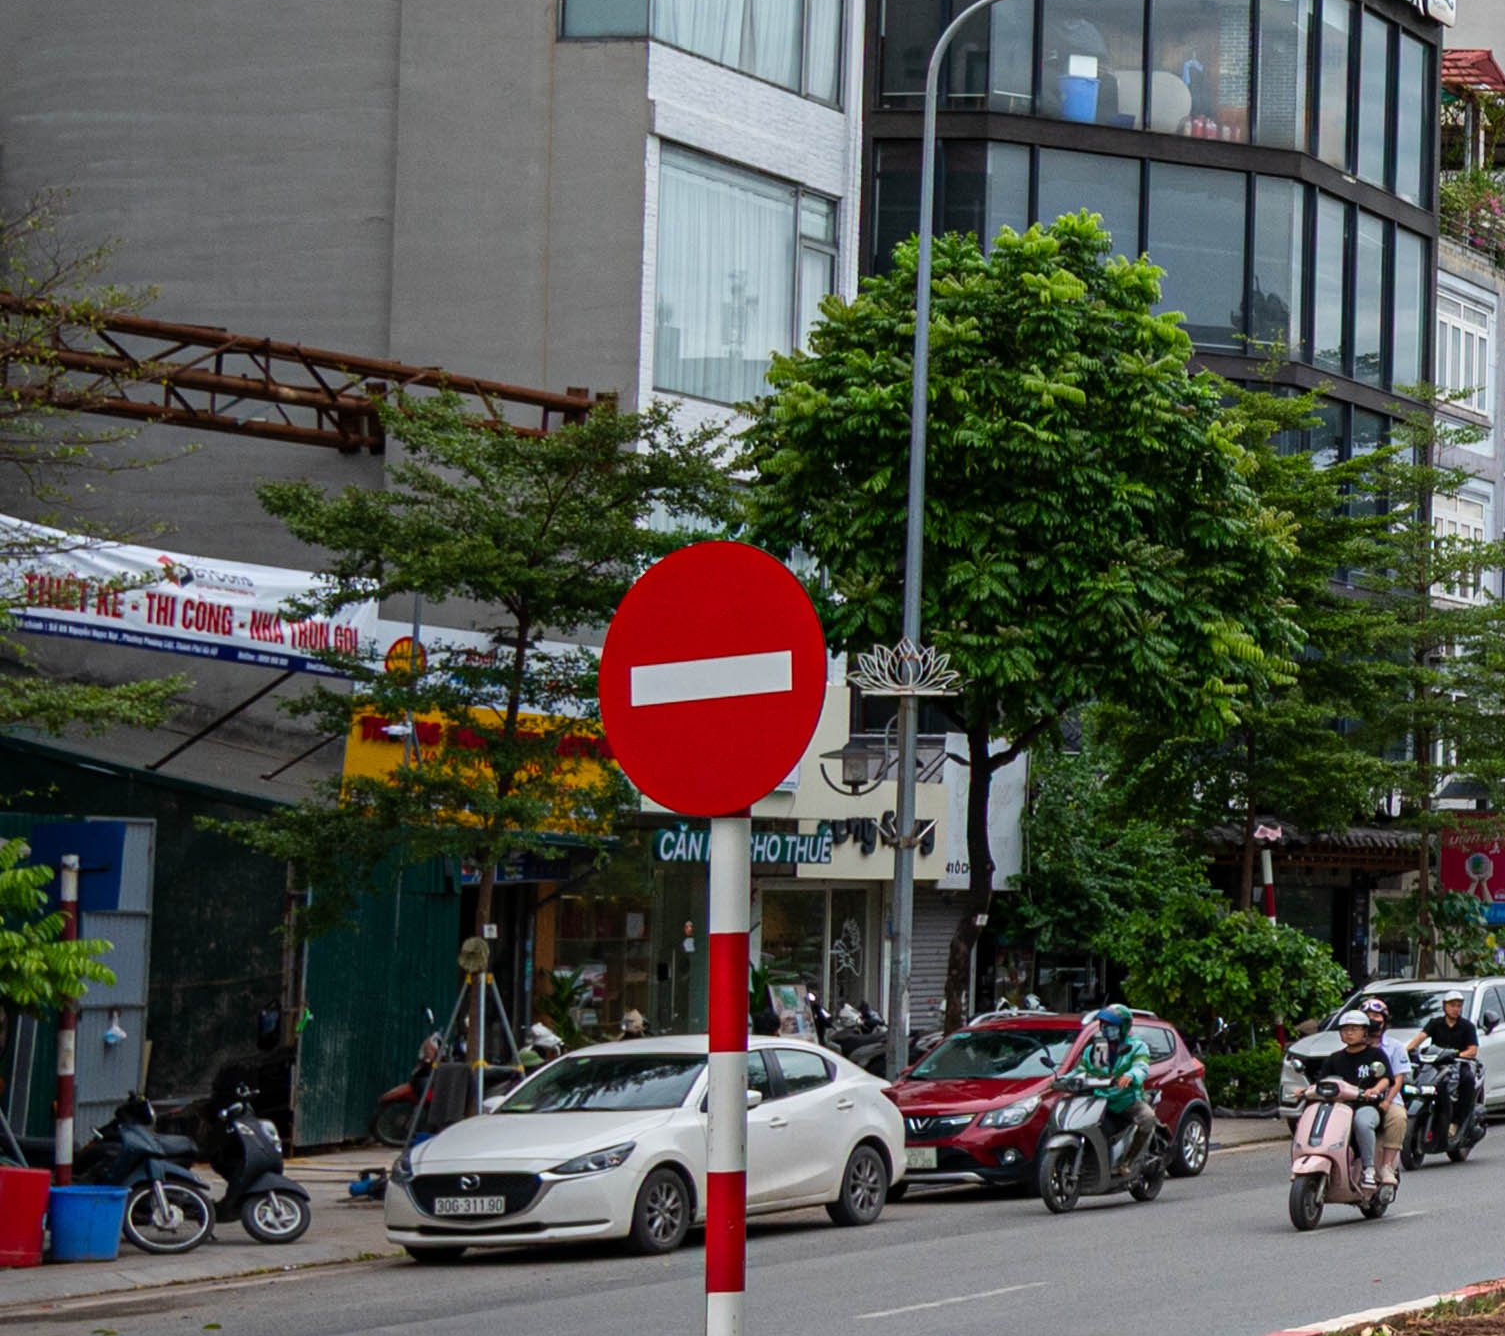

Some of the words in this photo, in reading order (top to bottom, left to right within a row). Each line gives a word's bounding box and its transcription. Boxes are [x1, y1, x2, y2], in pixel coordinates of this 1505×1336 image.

[146, 592, 177, 627] THI
[660, 824, 701, 863] CĂN
[784, 829, 834, 863] THUÊ
